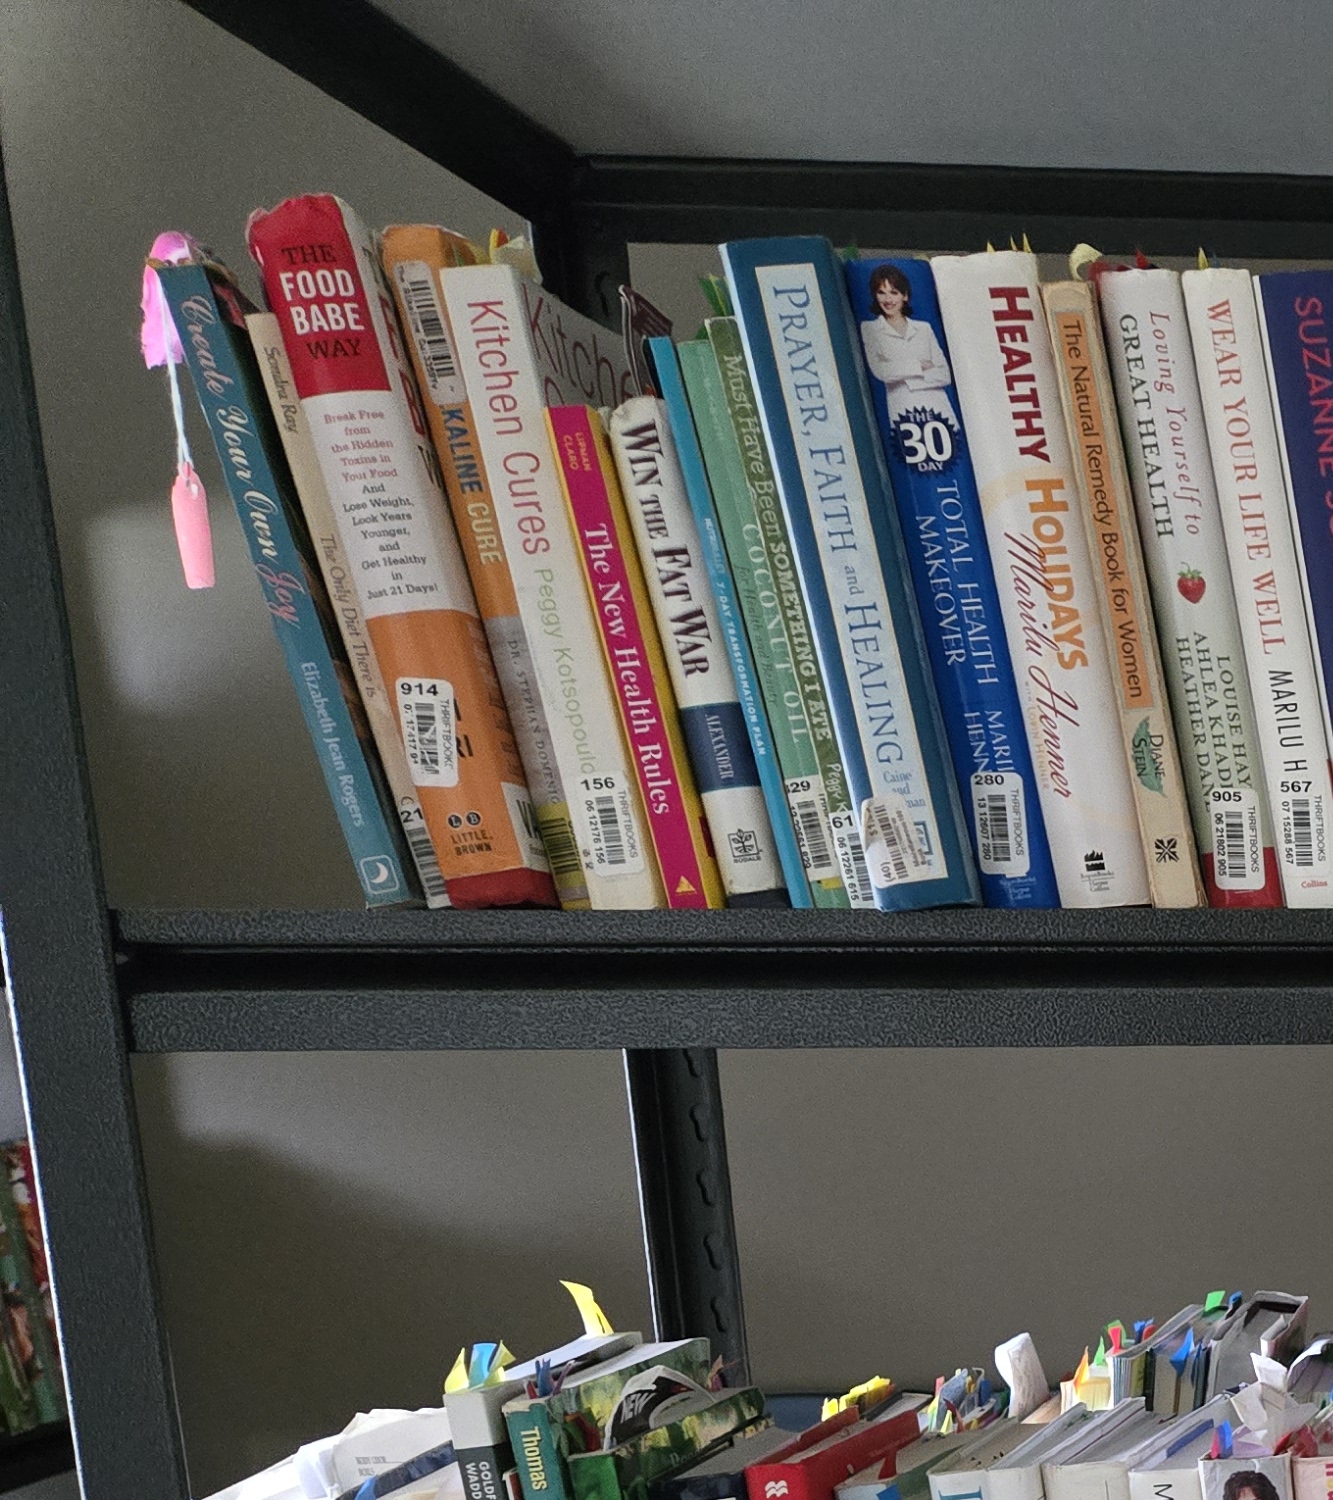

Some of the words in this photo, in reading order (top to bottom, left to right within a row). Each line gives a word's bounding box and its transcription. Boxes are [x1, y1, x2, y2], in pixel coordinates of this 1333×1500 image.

[278, 268, 357, 302] FOOD
[280, 242, 336, 264] THE
[291, 302, 365, 336] BABE
[305, 336, 362, 360] WAY
[1060, 320, 1082, 359] The
[1205, 297, 1241, 387] WEAR
[772, 283, 830, 439] PRAYER,
[467, 299, 525, 437] Kitchen
[503, 447, 551, 557] Cures
[1070, 363, 1098, 439] Natural
[623, 419, 664, 486] WIN
[989, 285, 1052, 463] HEALTHY
[1026, 477, 1089, 669] HOLIDAYS
[1223, 398, 1257, 486] YOUR
[643, 493, 669, 539] THE
[809, 444, 857, 555] FAITH
[1085, 443, 1112, 526] Remedy
[1100, 532, 1121, 584] Book
[1238, 492, 1271, 563] LIFE
[652, 545, 694, 616] FAT
[844, 563, 863, 595] and
[1111, 588, 1130, 616] for
[1250, 570, 1287, 656] WELL
[582, 521, 612, 566] The
[599, 577, 627, 634] New
[614, 643, 653, 735] Health
[637, 741, 671, 817] Rules
[668, 613, 712, 679] WAR
[1115, 616, 1143, 701] Women
[401, 682, 438, 697] 914
[847, 600, 904, 764] HEALING
